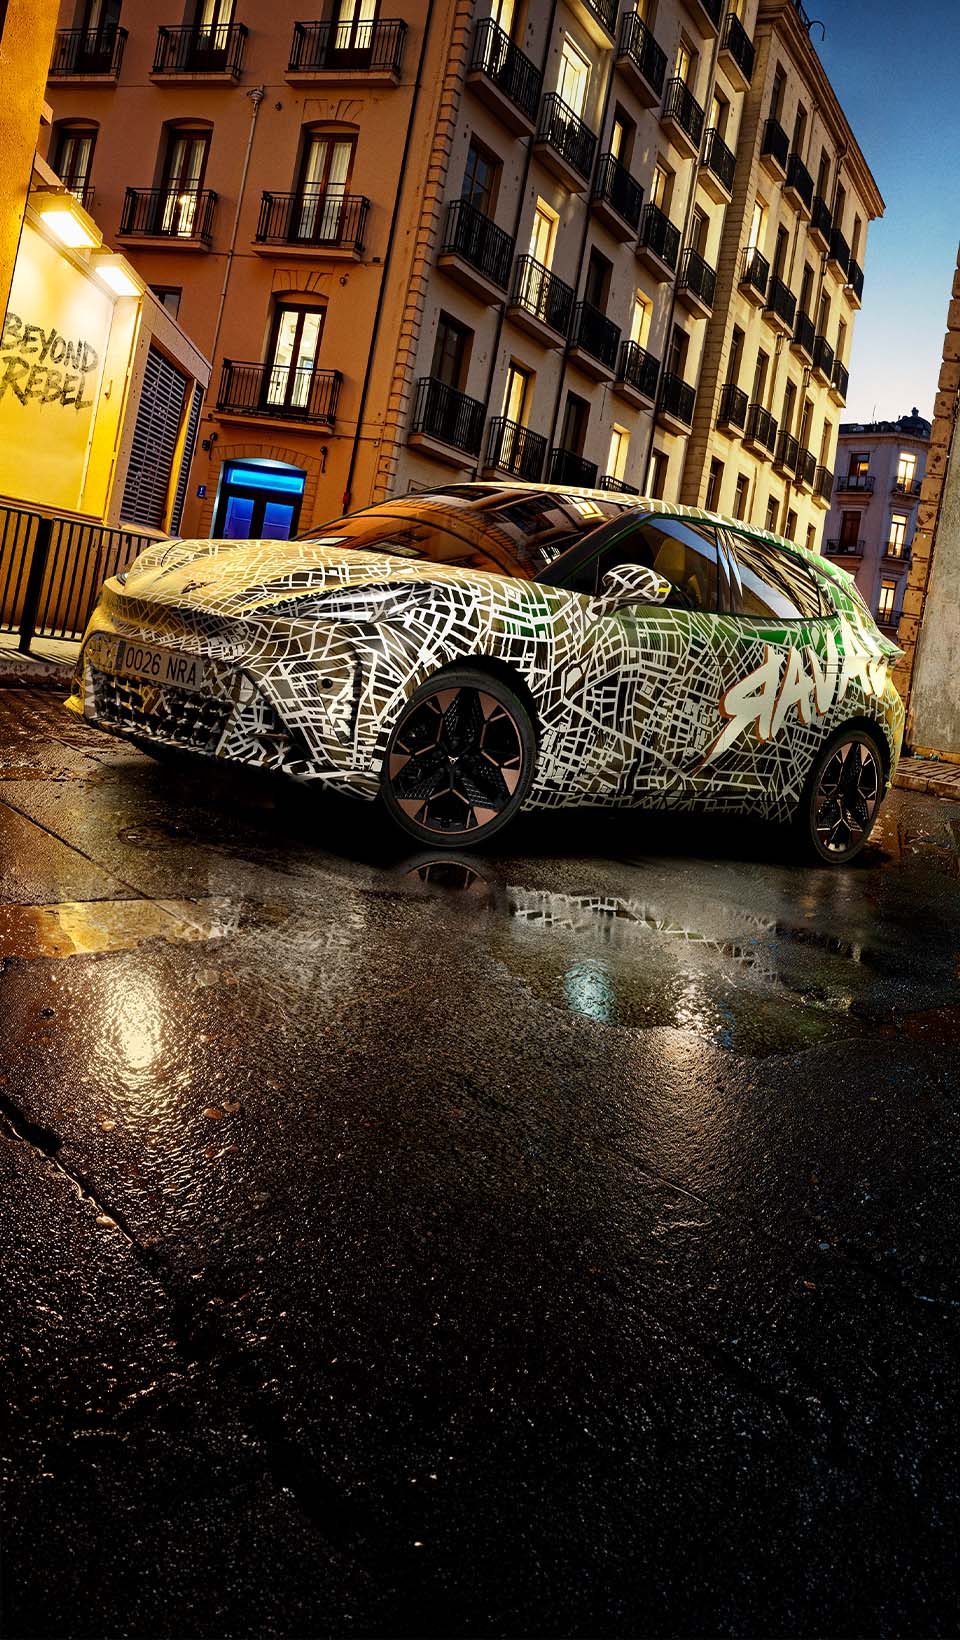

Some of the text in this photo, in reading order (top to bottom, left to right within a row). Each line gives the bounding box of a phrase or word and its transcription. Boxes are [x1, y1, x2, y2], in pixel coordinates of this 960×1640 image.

[1, 312, 99, 373] BEYOND
[2, 356, 94, 410] REBEL
[125, 647, 196, 687] 0026 NRA
